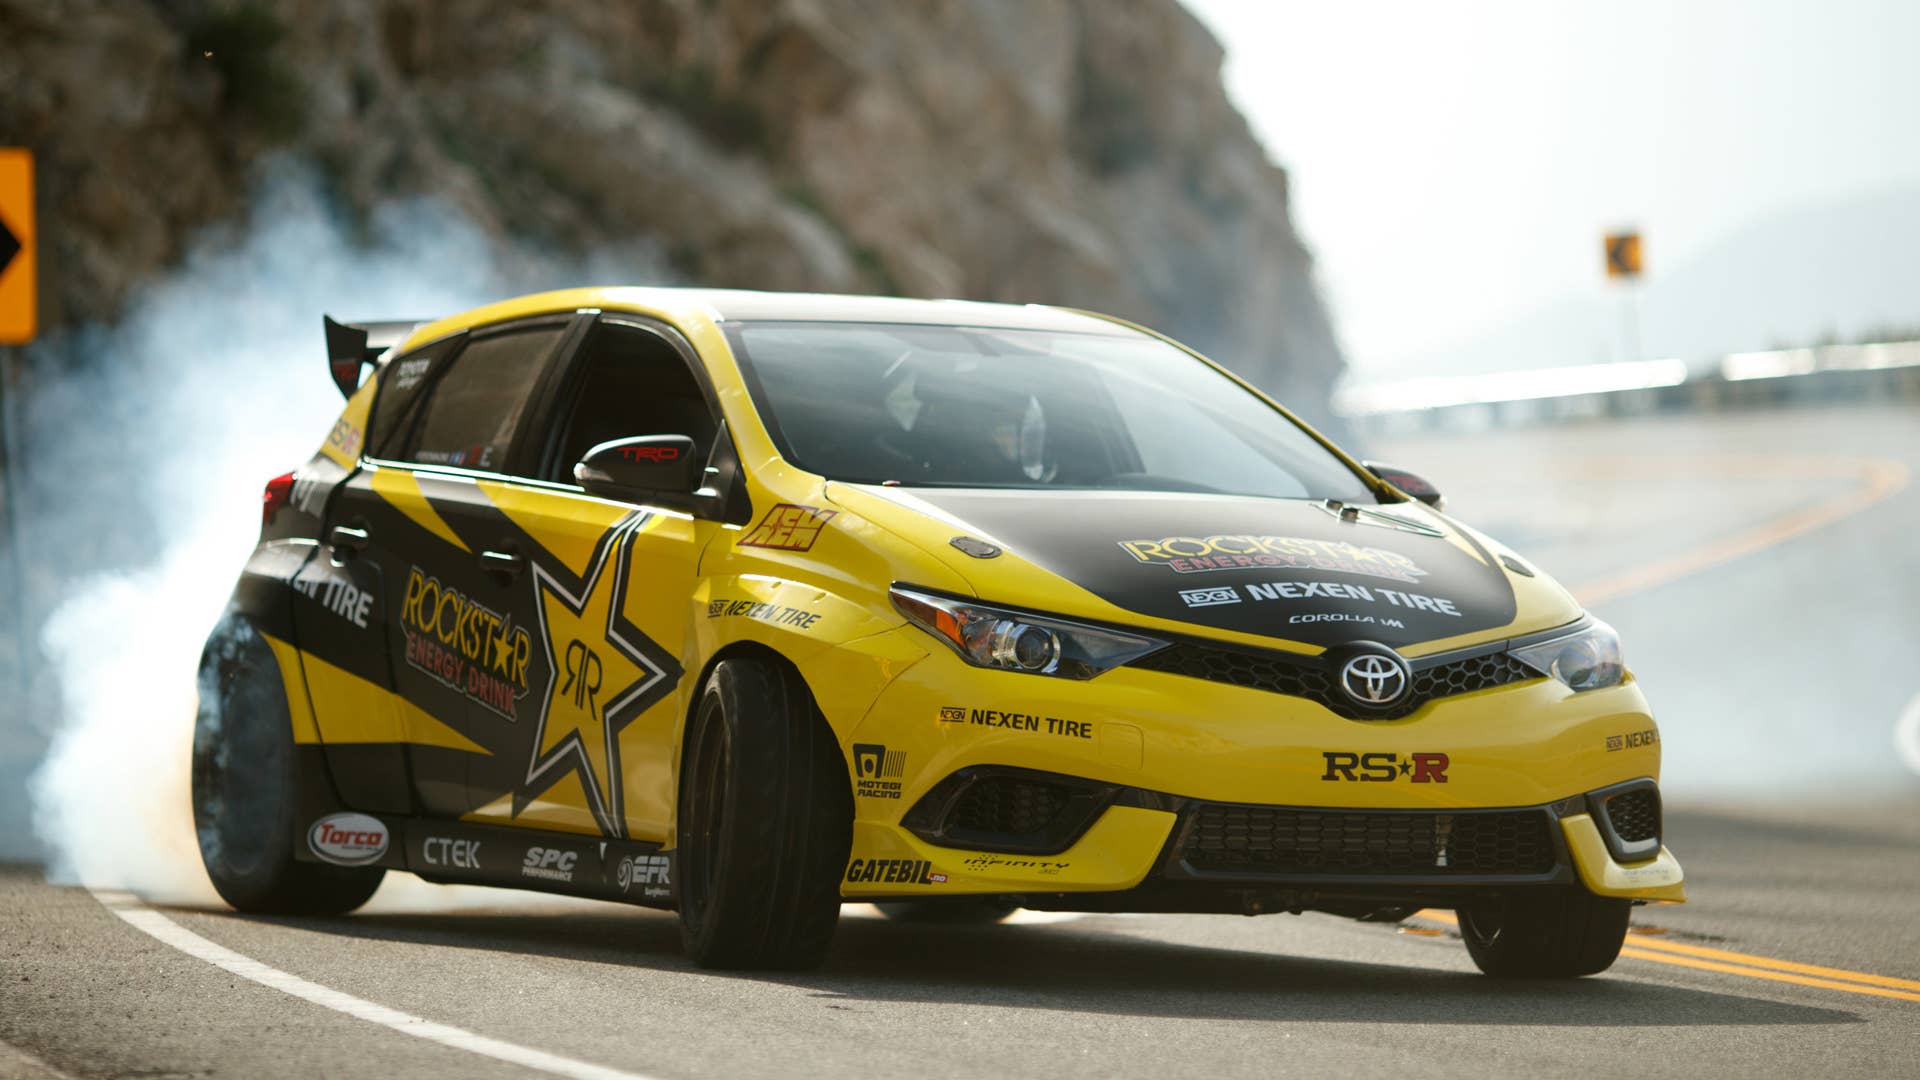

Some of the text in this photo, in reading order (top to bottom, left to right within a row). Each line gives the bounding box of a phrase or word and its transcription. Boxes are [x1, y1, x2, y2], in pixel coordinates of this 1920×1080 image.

[616, 446, 679, 463] TRD
[738, 503, 838, 551] AEM
[1122, 536, 1420, 576] ROCKSTAR
[1171, 554, 1298, 572] ENERGY
[322, 573, 375, 630] TIRE
[1245, 582, 1375, 601] NEXEN
[1374, 588, 1463, 617] TIRE
[724, 600, 780, 620] NEXEN
[775, 607, 822, 629] TIRE
[1289, 613, 1375, 624] COROLLA
[401, 570, 531, 689] ROCKSTAR
[407, 631, 516, 714] ENERGY DRINK
[970, 709, 1040, 732] NEXEN
[1045, 717, 1093, 739] TIRE
[857, 779, 902, 790] MOTEGI
[857, 789, 901, 799] RACING
[319, 824, 384, 846] Torco
[423, 837, 481, 869] CTEK
[523, 847, 578, 872] SPC
[963, 857, 1071, 869] INFINITY
[632, 855, 671, 885] EFR
